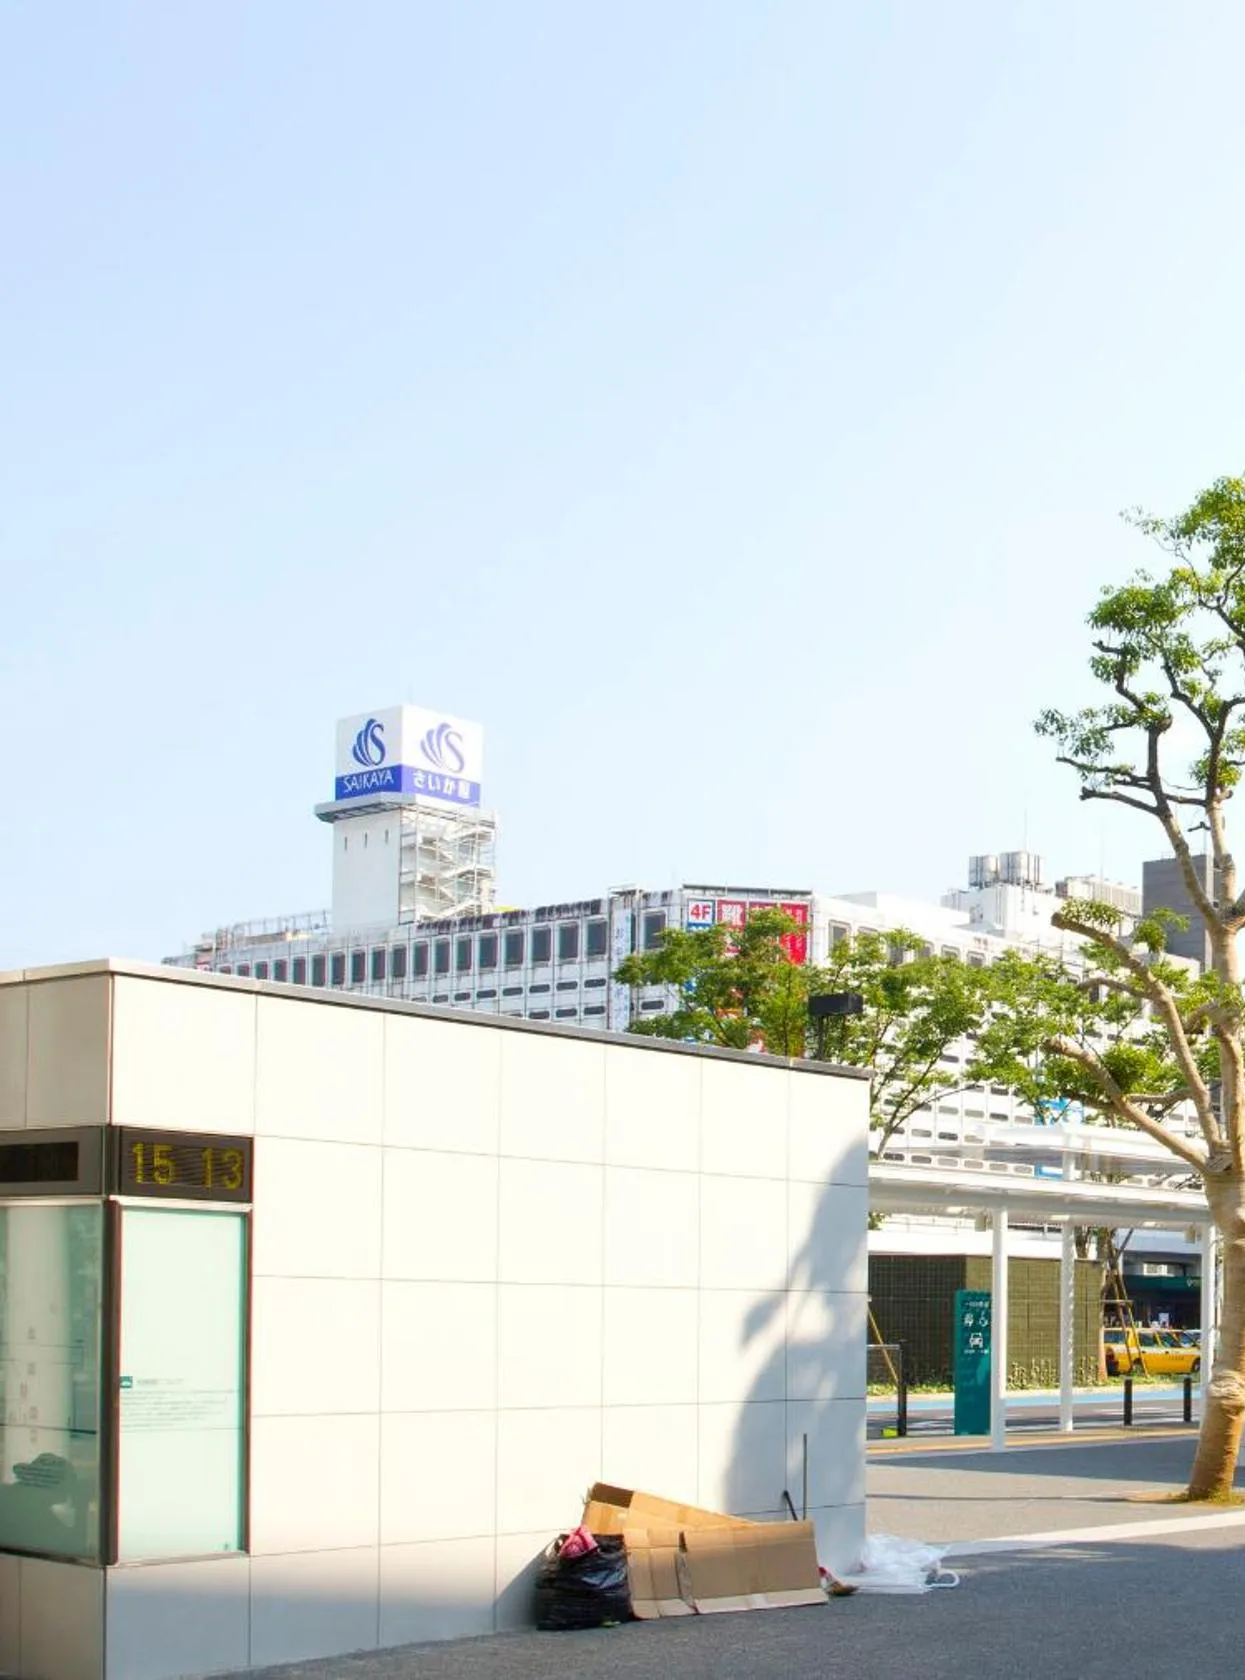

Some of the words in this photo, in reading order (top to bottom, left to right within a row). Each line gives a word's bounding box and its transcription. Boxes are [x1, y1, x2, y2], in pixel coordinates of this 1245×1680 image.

[343, 770, 394, 793] SAIKAYA
[690, 903, 711, 919] 4F
[132, 1142, 176, 1185] 15
[201, 1148, 243, 1190] 13
